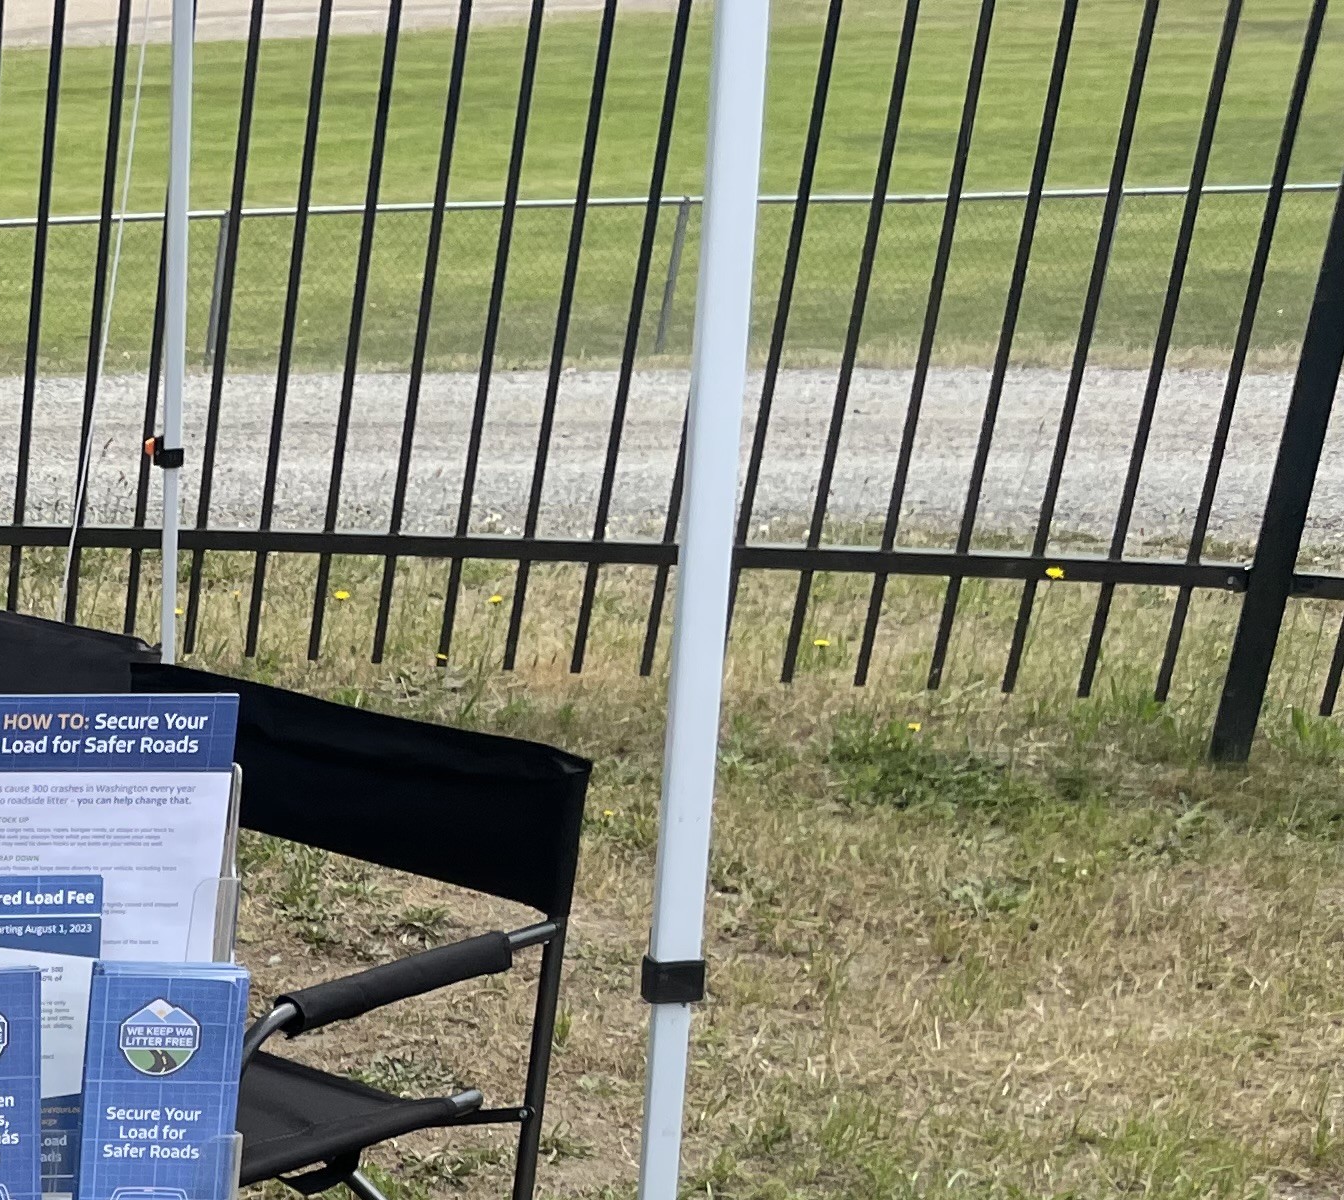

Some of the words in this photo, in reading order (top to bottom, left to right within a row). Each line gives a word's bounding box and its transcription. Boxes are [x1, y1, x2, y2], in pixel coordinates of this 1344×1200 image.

[3, 713, 53, 730] HOW
[57, 713, 90, 730] TO:
[94, 713, 159, 730] Secure
[163, 713, 208, 730] Your
[1, 737, 49, 754] Load
[51, 736, 81, 754] for
[84, 736, 137, 754] Safer
[140, 736, 199, 754] Roads
[5, 786, 30, 794] cause
[32, 785, 49, 794] 300
[50, 785, 84, 794] crashes
[85, 785, 94, 793] in
[96, 785, 149, 795] Washington
[150, 786, 174, 795] every
[175, 786, 197, 795] year
[7, 797, 45, 805] roadside
[47, 797, 68, 805] litter
[77, 798, 93, 807] you
[113, 796, 134, 807] help
[134, 796, 168, 807] change
[169, 796, 192, 805] that.
[25, 891, 64, 906] Load
[68, 891, 95, 905] Fee
[25, 924, 57, 936] August
[59, 924, 68, 935] 1,
[69, 923, 93, 934] 2023
[126, 1027, 143, 1036] WE
[146, 1027, 172, 1036] KEEP
[174, 1027, 194, 1036] WA
[125, 1037, 161, 1047] LITTER
[164, 1037, 194, 1047] FREE
[105, 1106, 161, 1121] Secure
[164, 1107, 202, 1121] Your
[119, 1125, 159, 1140] Load
[161, 1125, 187, 1140] for
[102, 1144, 146, 1159] Safer
[149, 1144, 200, 1159] Roads
